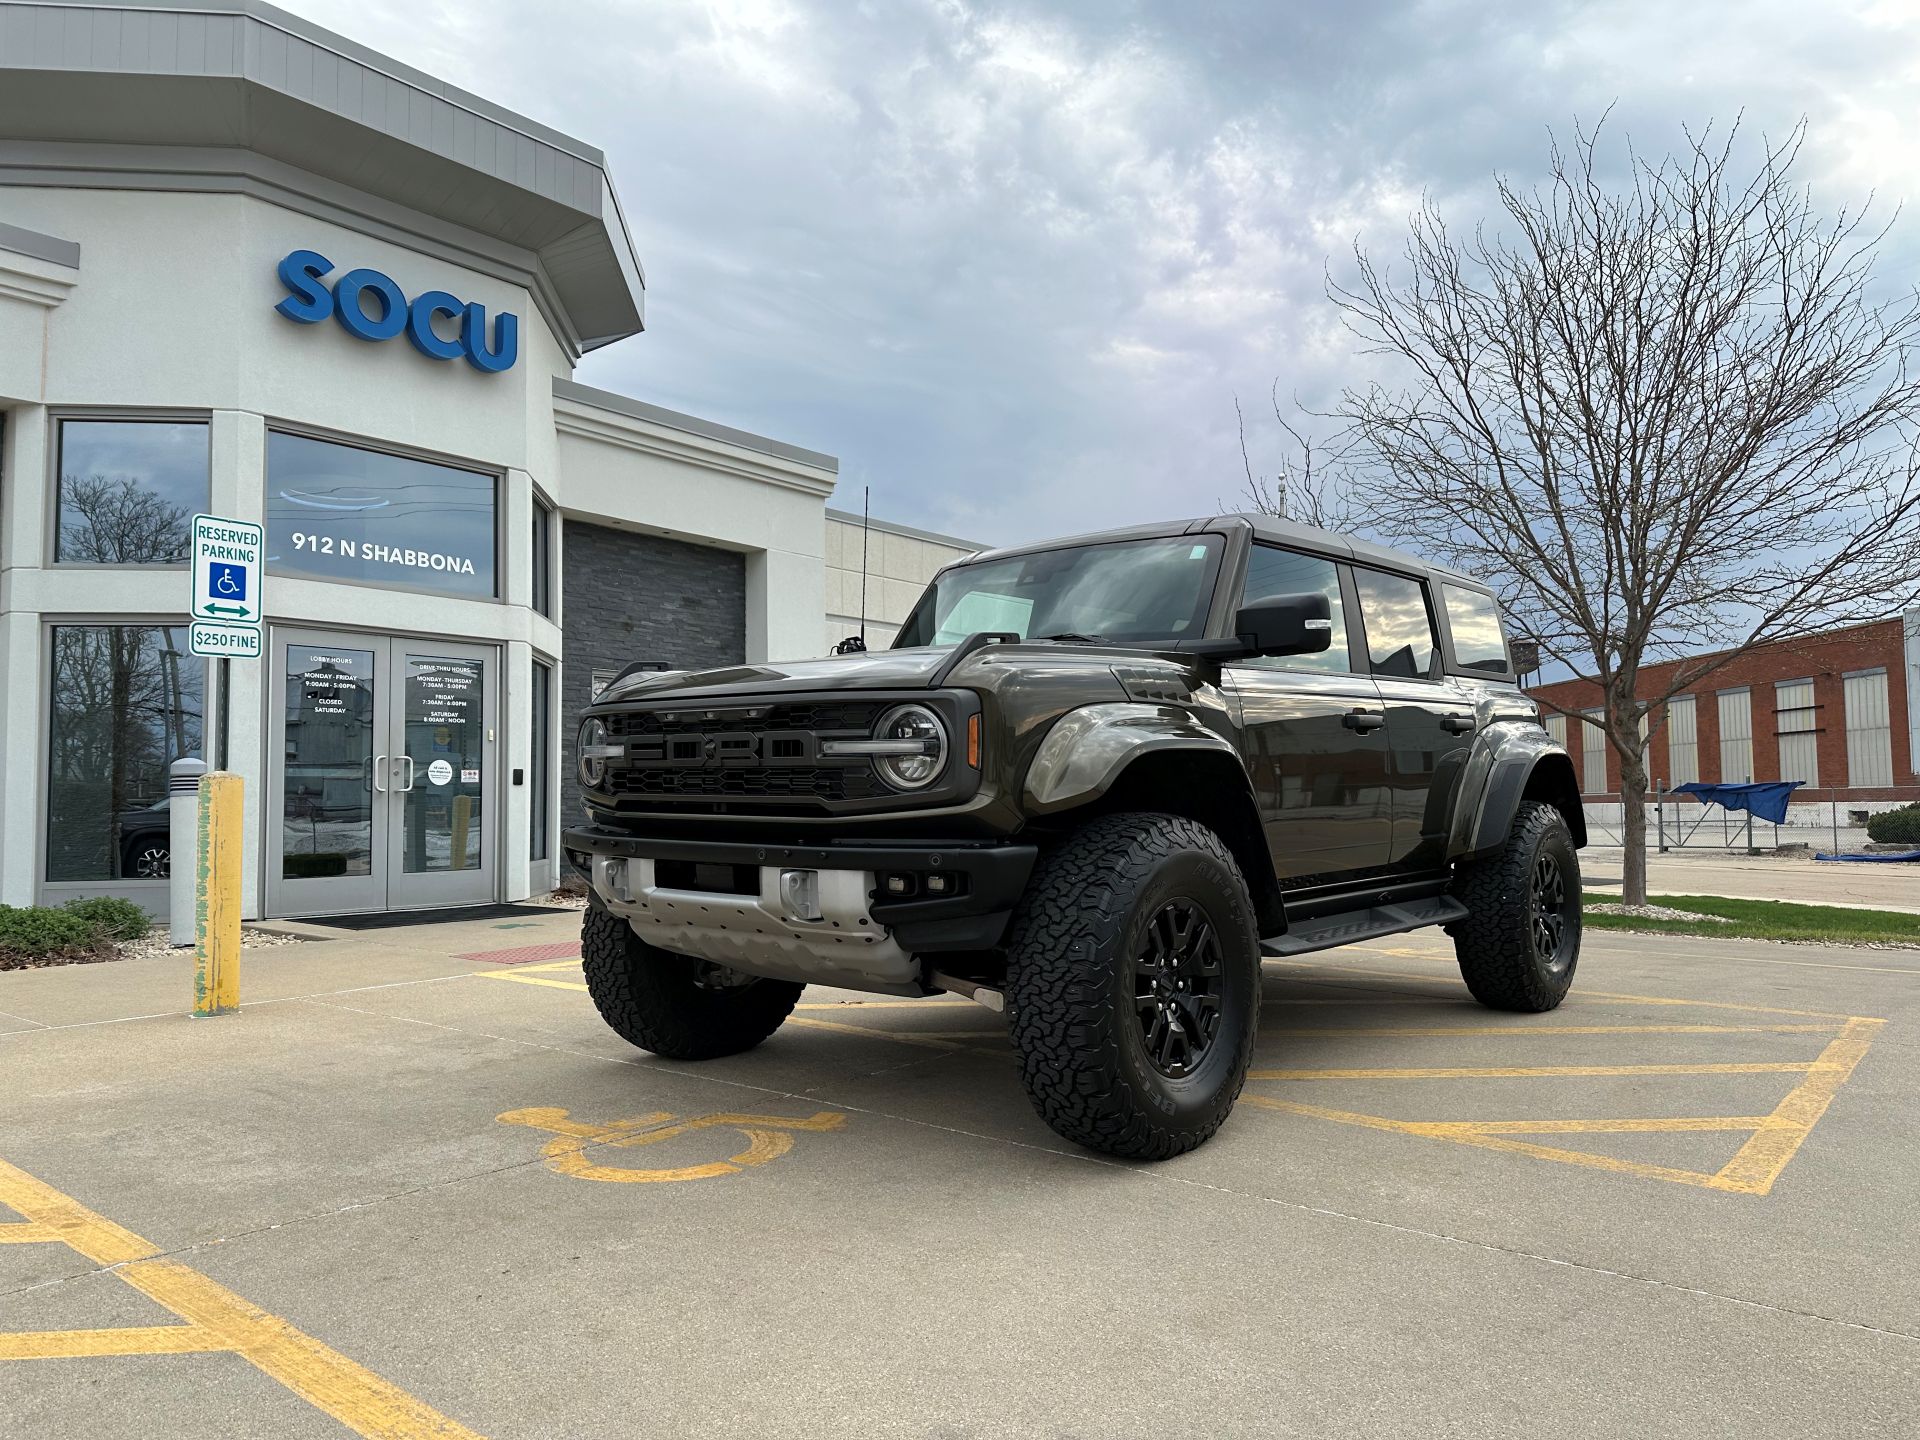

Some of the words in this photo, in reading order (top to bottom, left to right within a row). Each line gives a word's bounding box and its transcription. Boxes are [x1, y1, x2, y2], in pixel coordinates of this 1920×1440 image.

[274, 249, 518, 374] SOCU
[198, 525, 259, 546] RESERVED
[201, 543, 255, 563] PARKING
[291, 532, 334, 555] 912
[340, 539, 356, 558] N
[361, 543, 475, 575] SHABBONA
[195, 630, 228, 646] $250
[229, 634, 257, 648] FINE
[305, 680, 329, 688] 9:00AM
[624, 730, 816, 768] FORD
